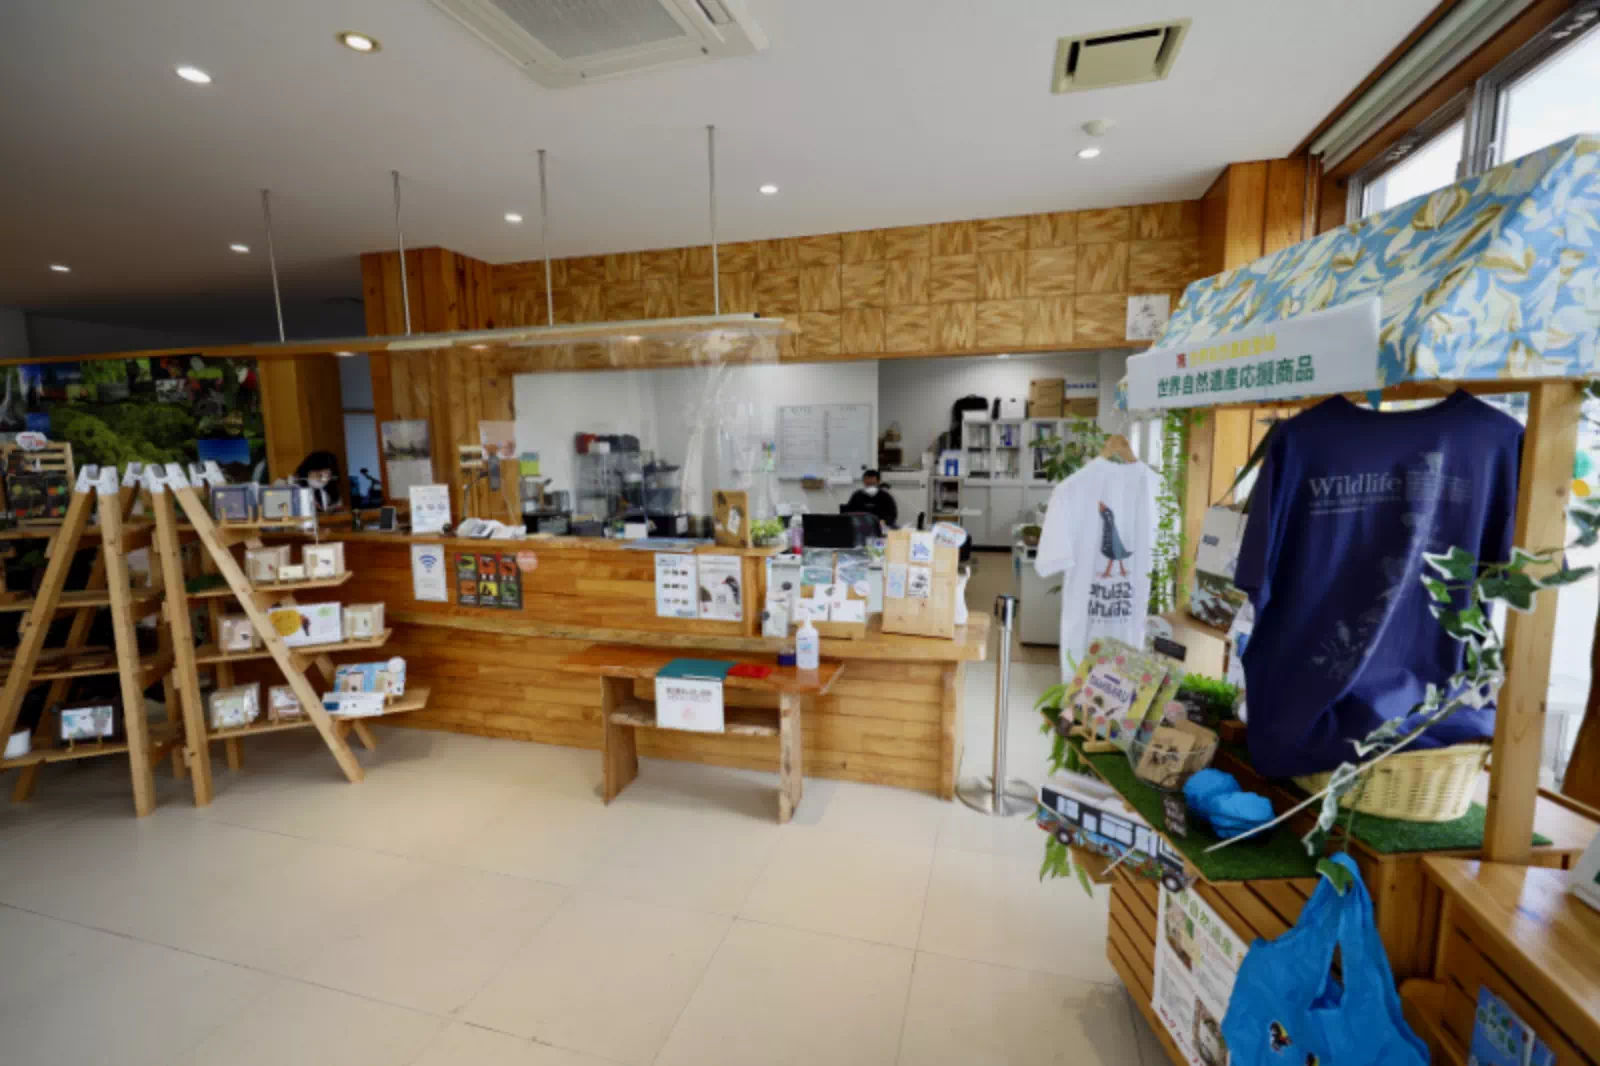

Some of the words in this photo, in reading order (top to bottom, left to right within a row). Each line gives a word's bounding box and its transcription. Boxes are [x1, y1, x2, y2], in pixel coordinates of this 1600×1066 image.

[1157, 355, 1315, 398] 世界自然遺産応援商品
[1308, 472, 1402, 497] Wildlife
